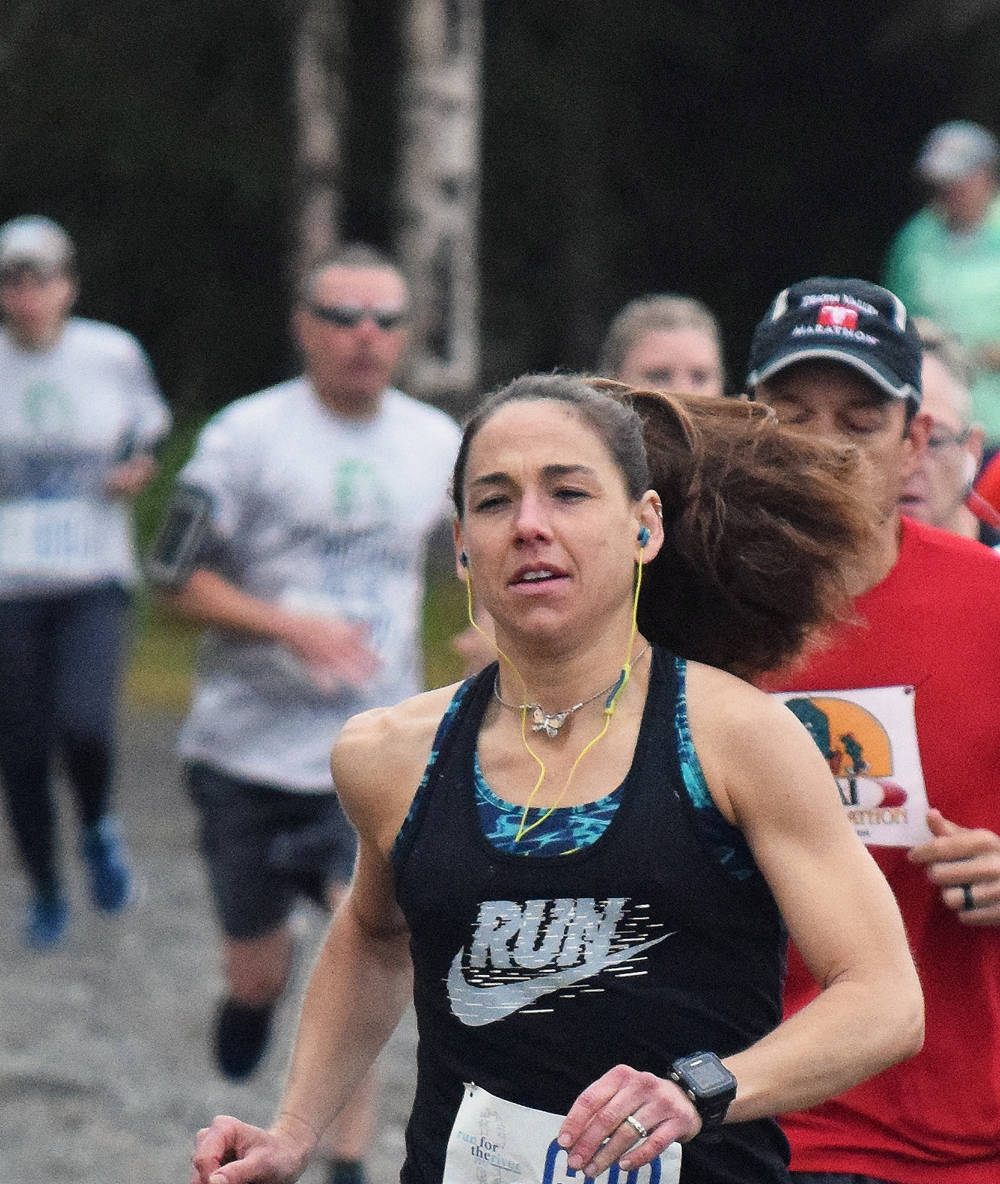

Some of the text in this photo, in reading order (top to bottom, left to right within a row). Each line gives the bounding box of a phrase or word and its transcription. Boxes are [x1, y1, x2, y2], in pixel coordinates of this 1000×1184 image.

[791, 325, 880, 346] MARATHON
[470, 898, 630, 969] RUN
[479, 1136, 499, 1153] for
